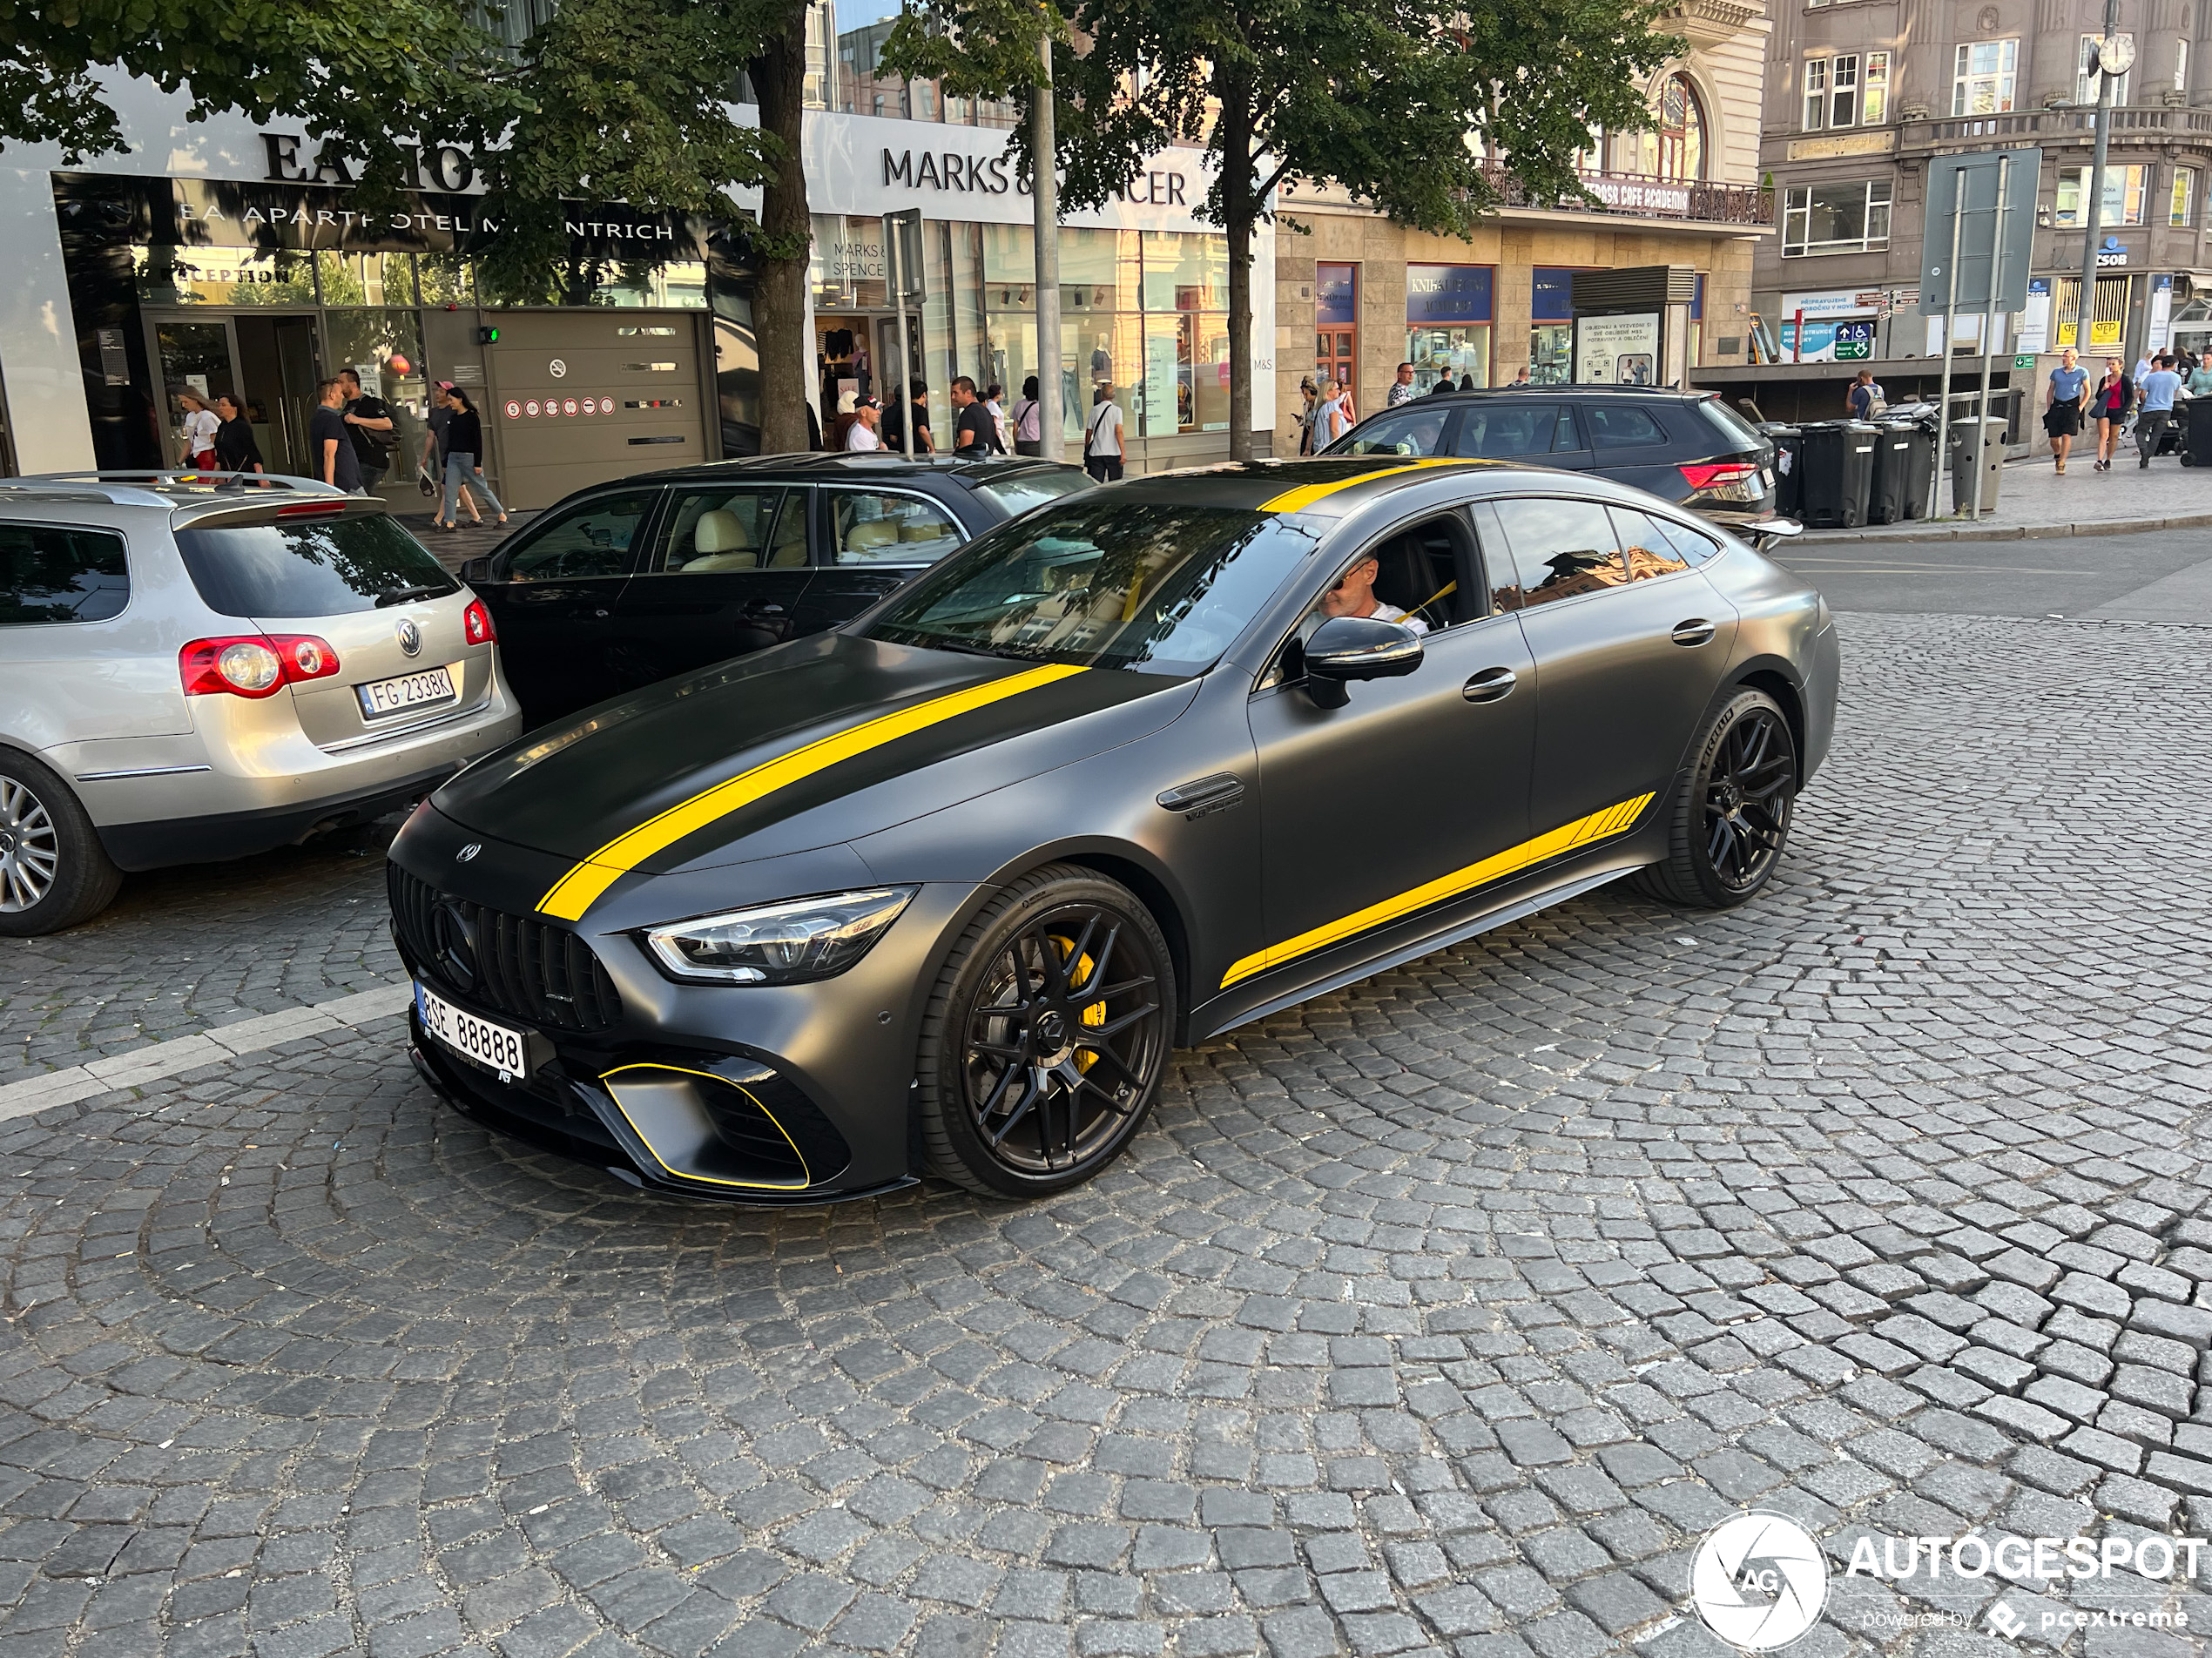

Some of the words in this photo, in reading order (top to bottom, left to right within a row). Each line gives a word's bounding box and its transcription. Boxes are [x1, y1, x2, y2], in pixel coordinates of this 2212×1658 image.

[882, 148, 1008, 194] MARKS
[1645, 188, 1688, 211] ACADEMIA
[179, 203, 226, 221] EA
[834, 243, 879, 258] MARKS
[833, 262, 885, 277] SPENCE
[1254, 359, 1272, 371] M&S
[510, 405, 516, 414] 5
[372, 683, 399, 710] FG
[401, 671, 450, 703] 2338K
[1701, 707, 1734, 770] MICHELIN
[424, 992, 449, 1039] 8SE
[457, 1014, 519, 1071] 88888
